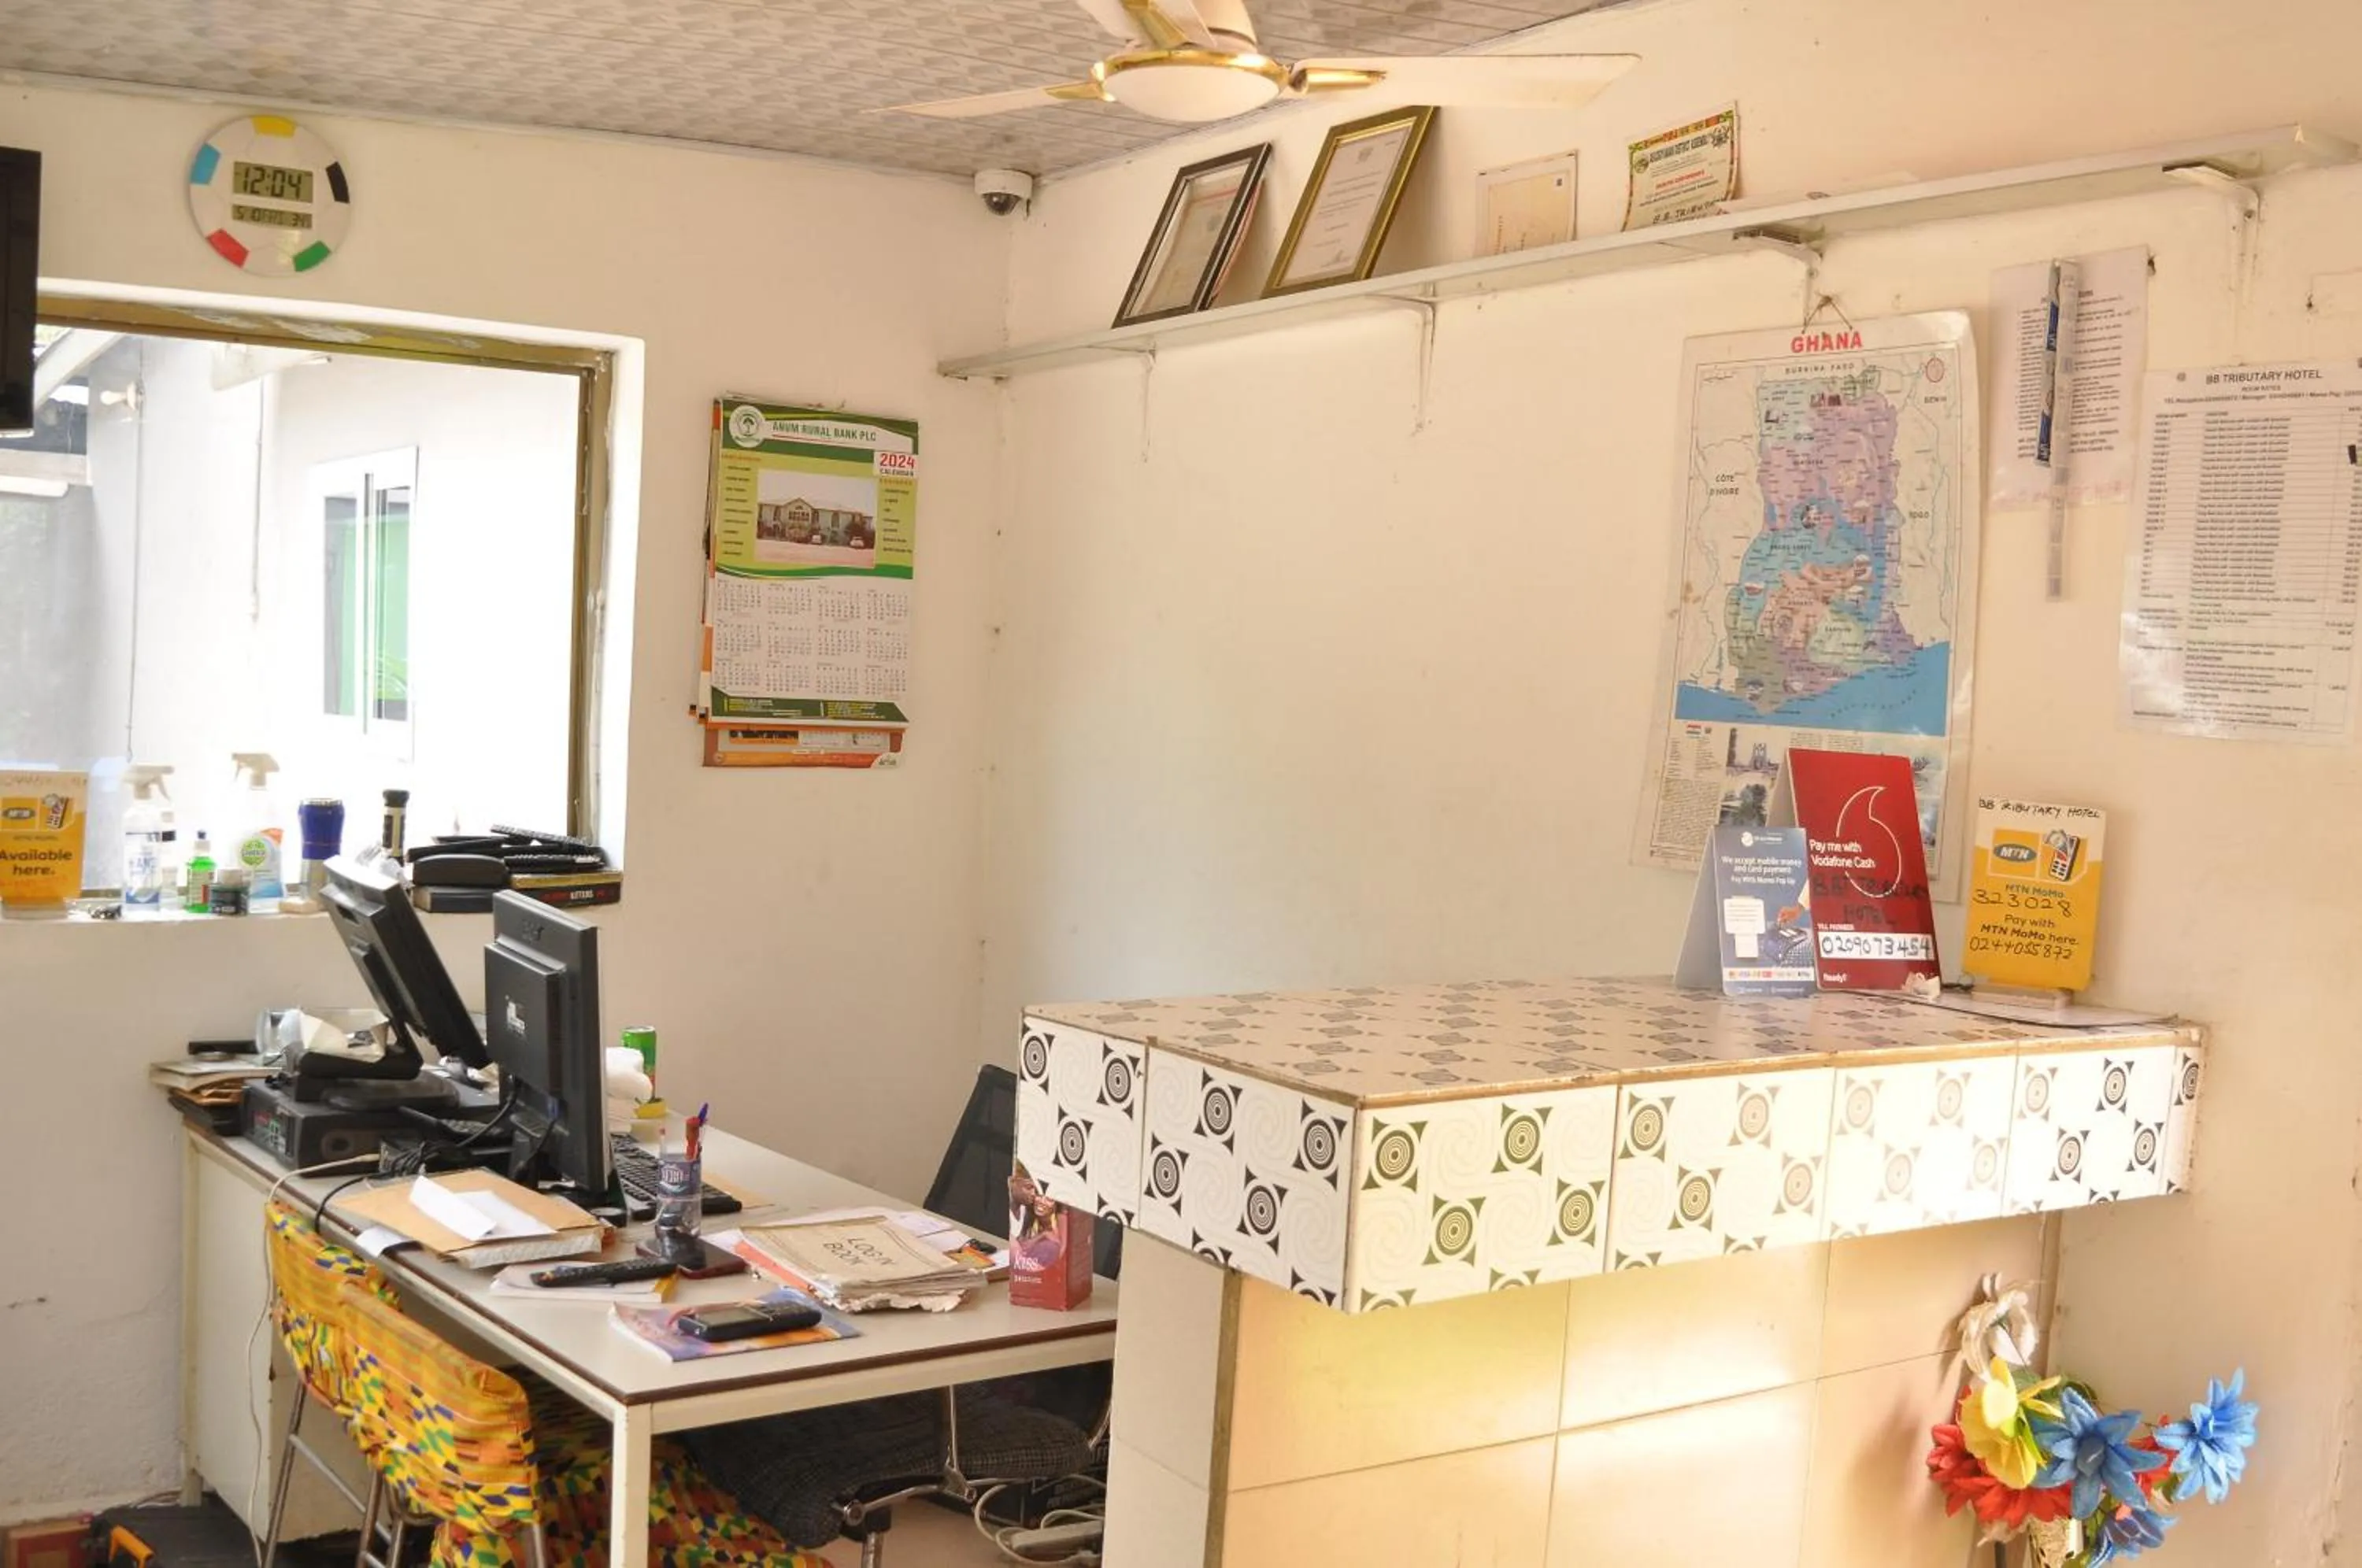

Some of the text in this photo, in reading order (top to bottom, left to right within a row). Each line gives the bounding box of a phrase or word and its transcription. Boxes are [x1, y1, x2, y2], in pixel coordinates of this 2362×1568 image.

[242, 166, 302, 199] 12:04
[1790, 331, 1863, 354] GHANA
[2223, 371, 2282, 383] TRIBUTARY
[2284, 369, 2323, 380] HOTEL
[834, 427, 857, 441] BANK
[860, 431, 876, 442] PLC
[879, 453, 915, 469] 2024
[2067, 808, 2101, 819] HOTEL
[1809, 838, 1862, 853] Pay me with
[2000, 845, 2030, 860] MTN
[0, 848, 72, 861] Available
[1811, 855, 1876, 868] Vodafone Cash
[13, 864, 57, 876] here.
[2005, 883, 2030, 893] MTN
[2005, 913, 2056, 928] Pay with
[1980, 923, 2008, 935] MTN
[2010, 928, 2046, 941] MoMo
